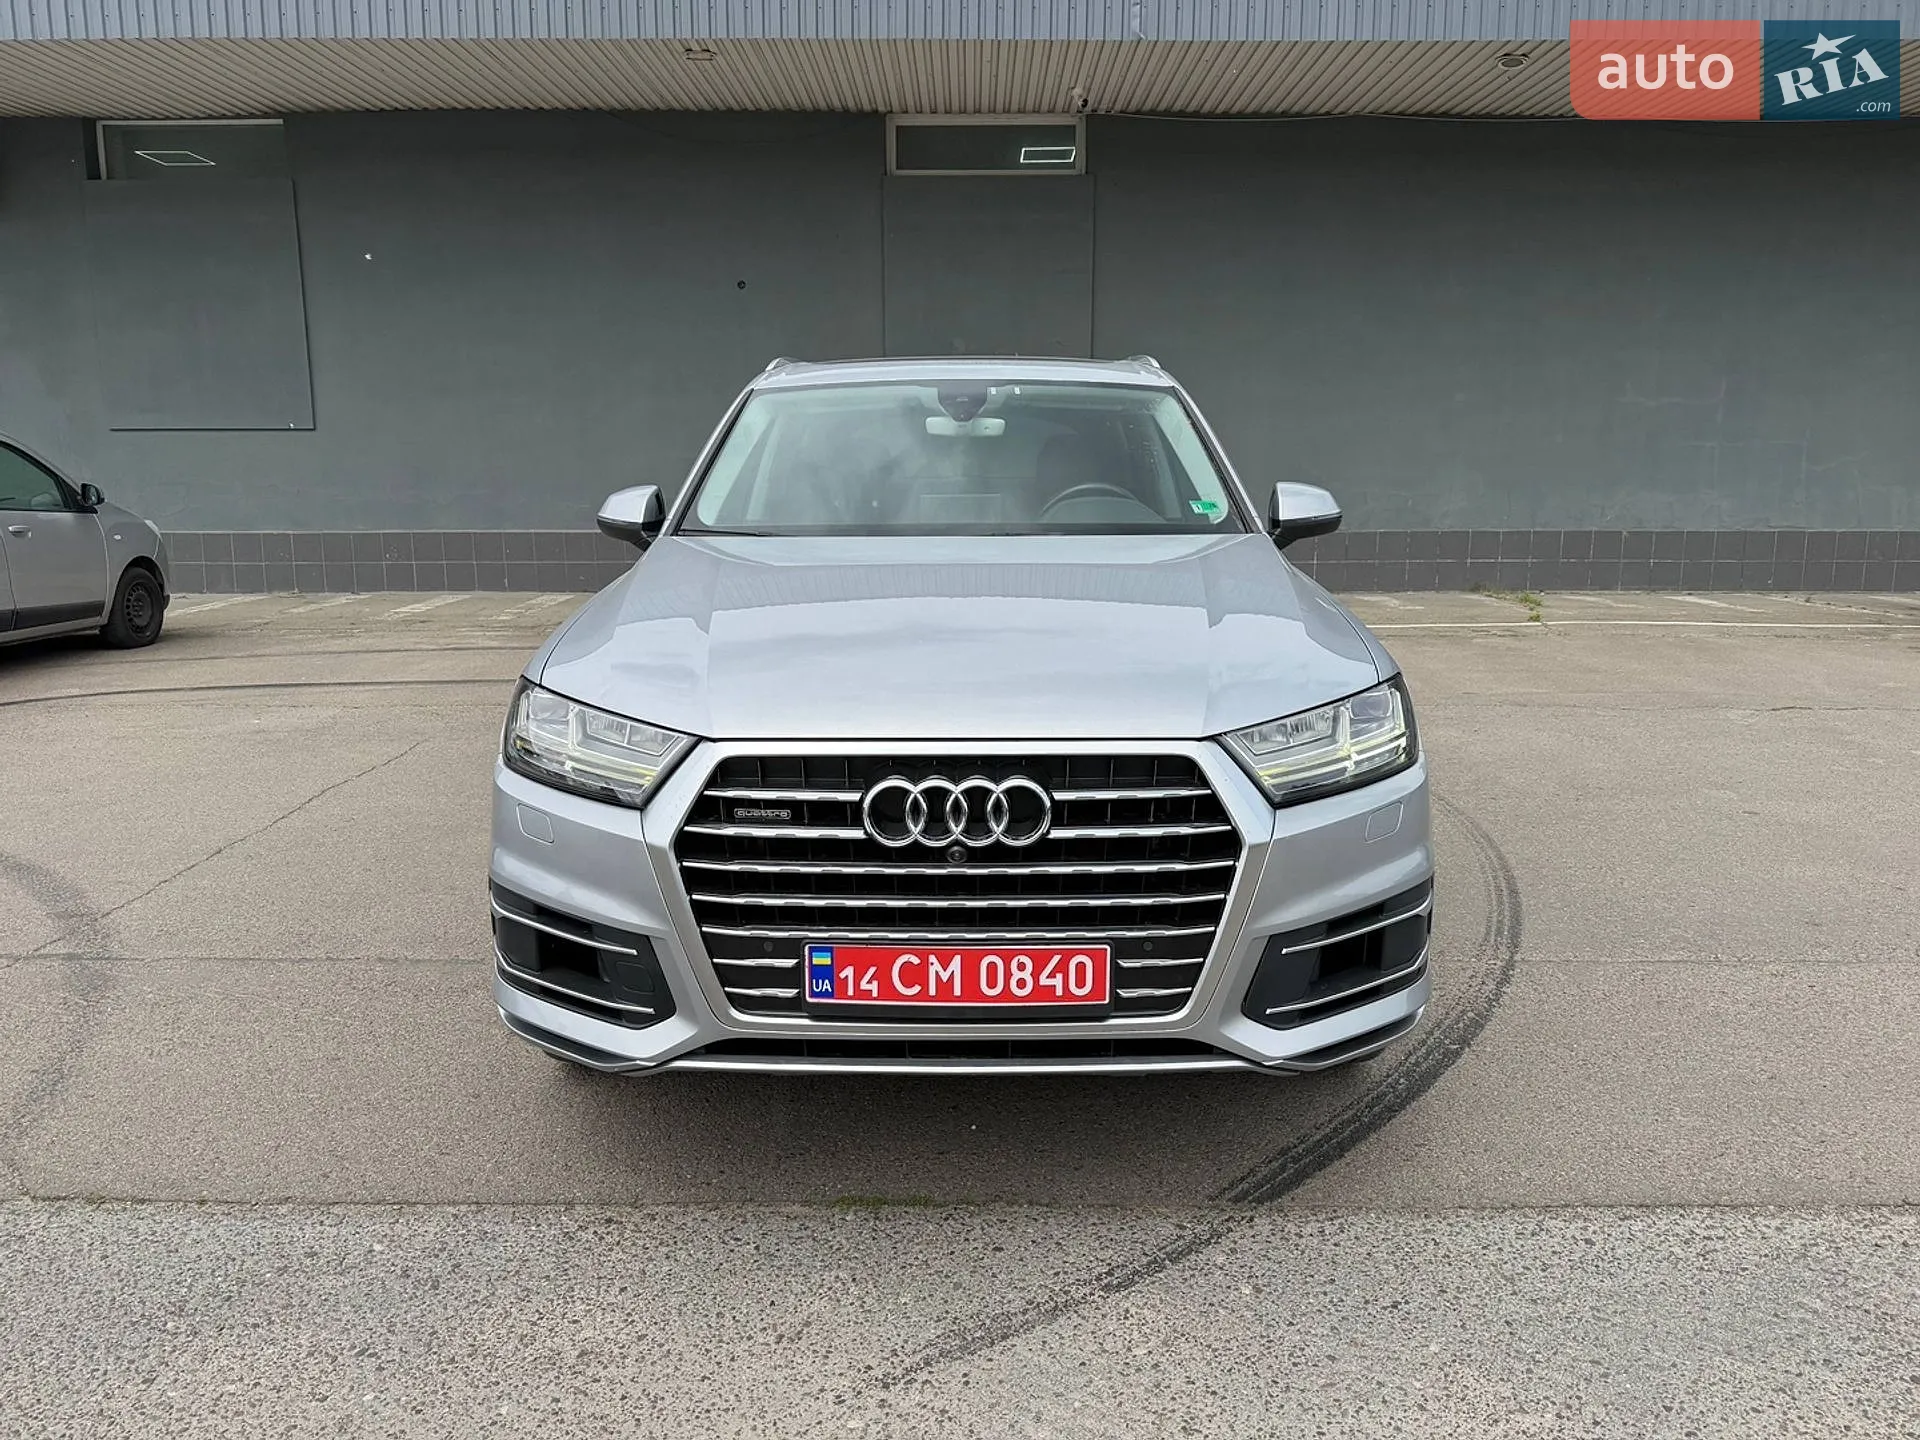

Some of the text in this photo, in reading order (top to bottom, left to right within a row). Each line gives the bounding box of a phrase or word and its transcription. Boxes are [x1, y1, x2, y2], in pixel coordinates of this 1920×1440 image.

[812, 979, 832, 993] UA
[838, 953, 1094, 998] 14 CM 0840
